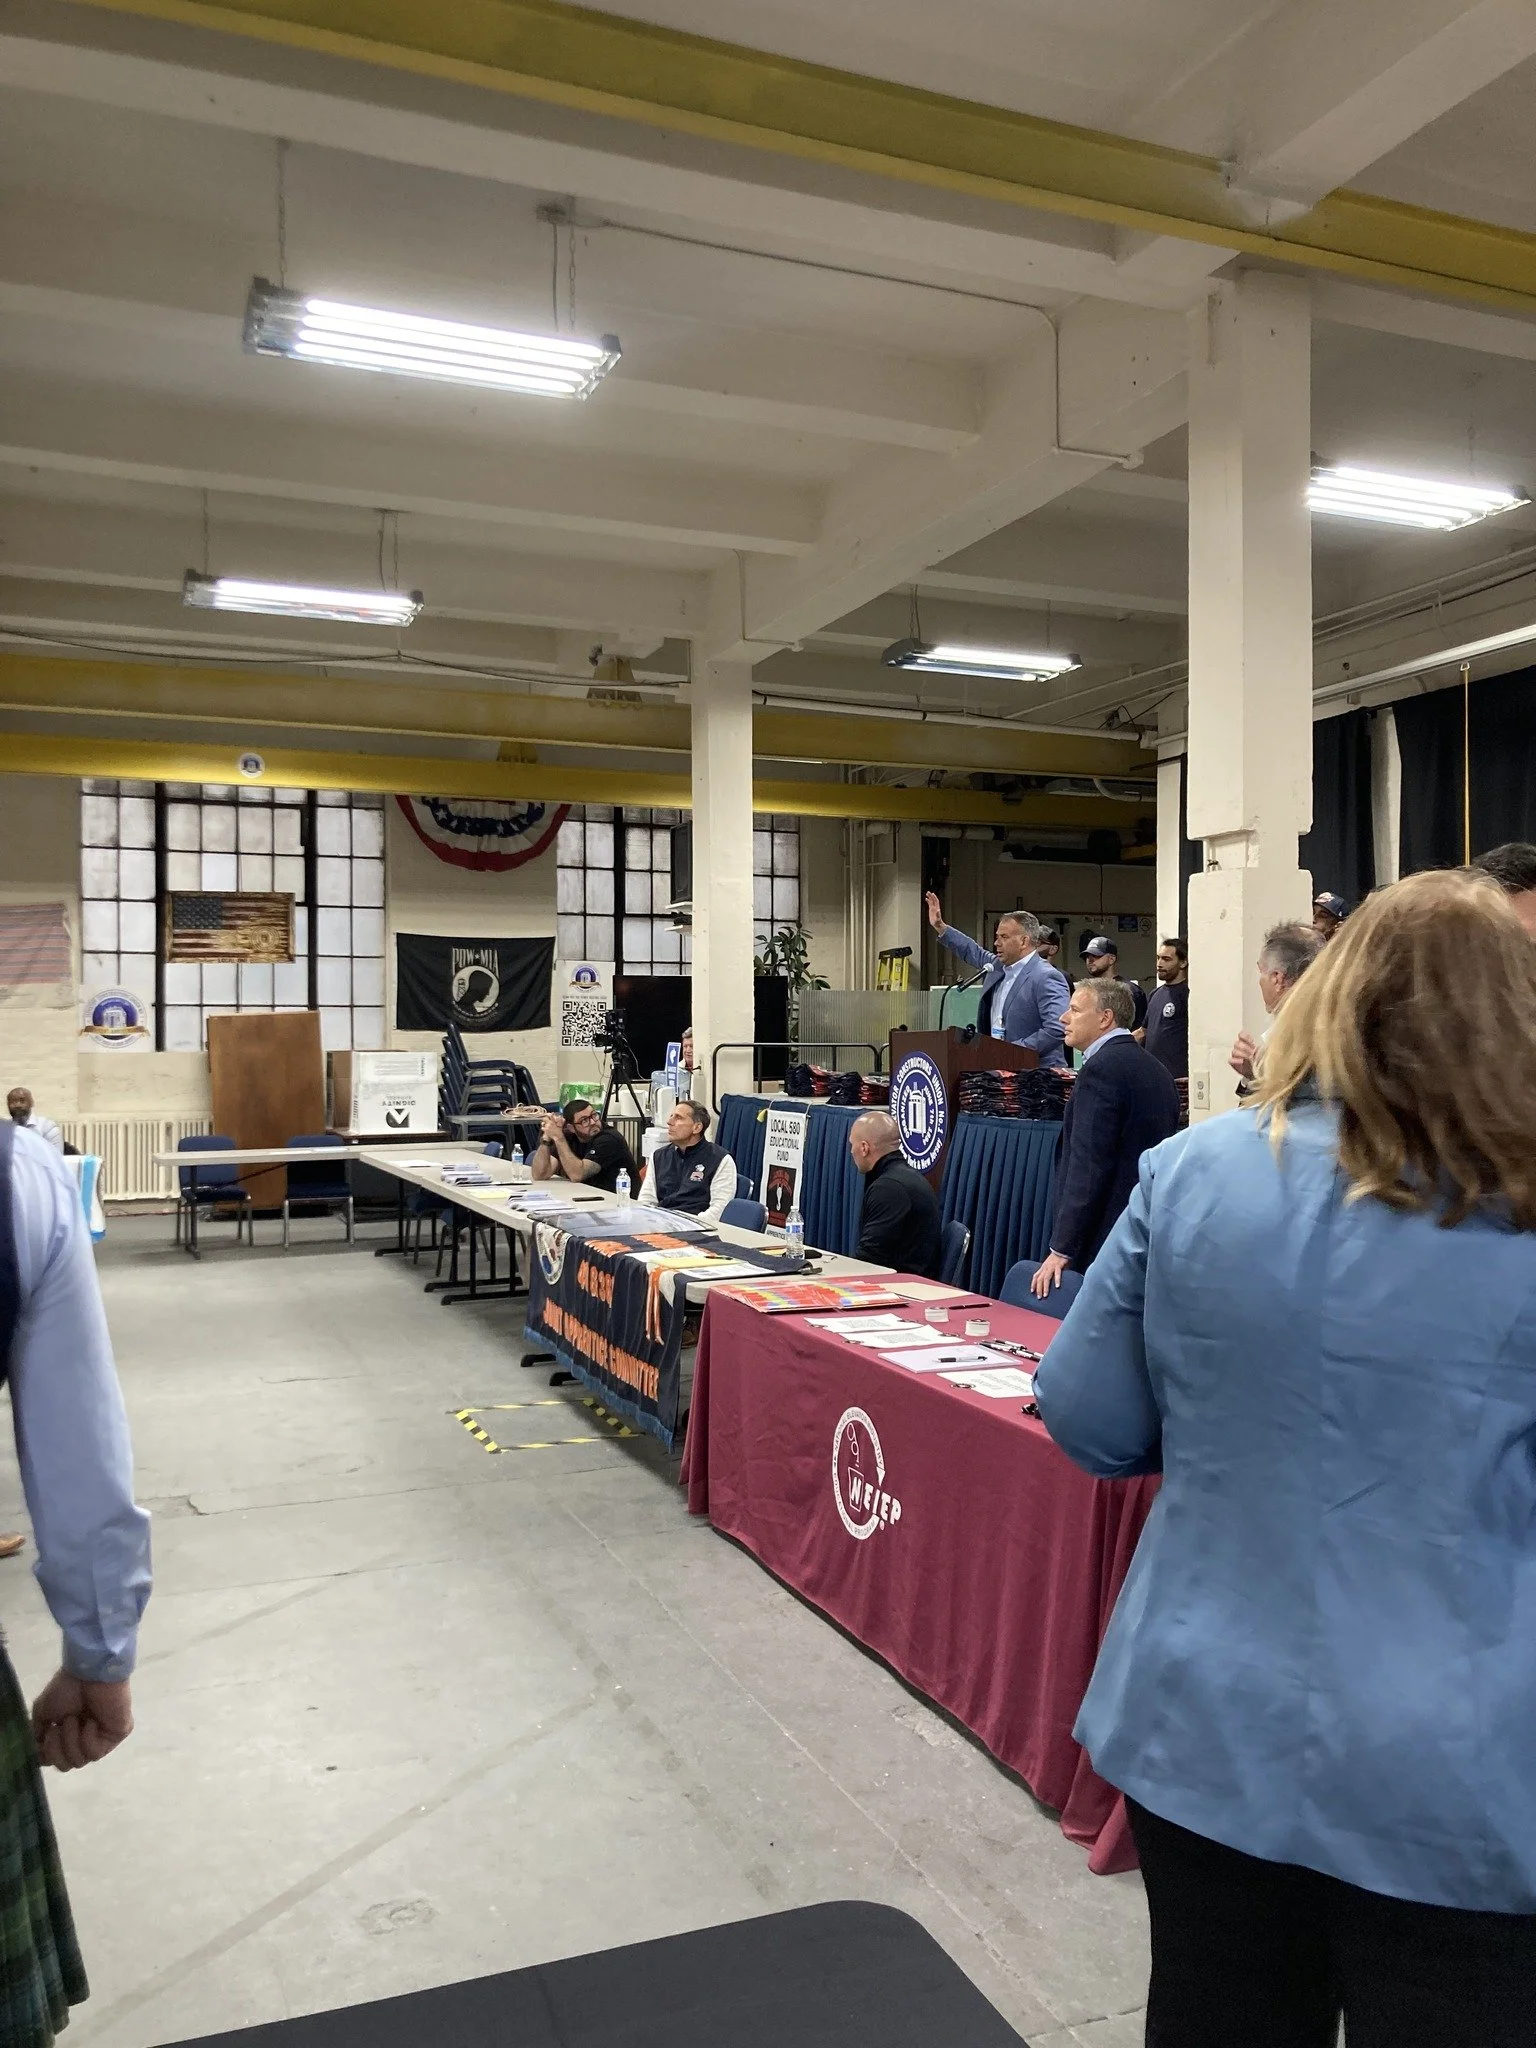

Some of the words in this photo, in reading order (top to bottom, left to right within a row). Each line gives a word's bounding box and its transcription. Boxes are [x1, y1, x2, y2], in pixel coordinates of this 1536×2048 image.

[452, 947, 475, 976] POW
[480, 949, 499, 979] MIA
[897, 1057, 932, 1083] CONSTRUCTORS
[932, 1074, 943, 1105] UNION
[770, 1118, 788, 1134] LOCAL
[788, 1121, 801, 1135] 580
[900, 1085, 910, 1139] ORGANIZED
[769, 1136, 799, 1150] EDUCATIONAL
[776, 1150, 789, 1162] FUND
[608, 1342, 660, 1402] COMMITTEE
[851, 1476, 902, 1525] NEIEP
